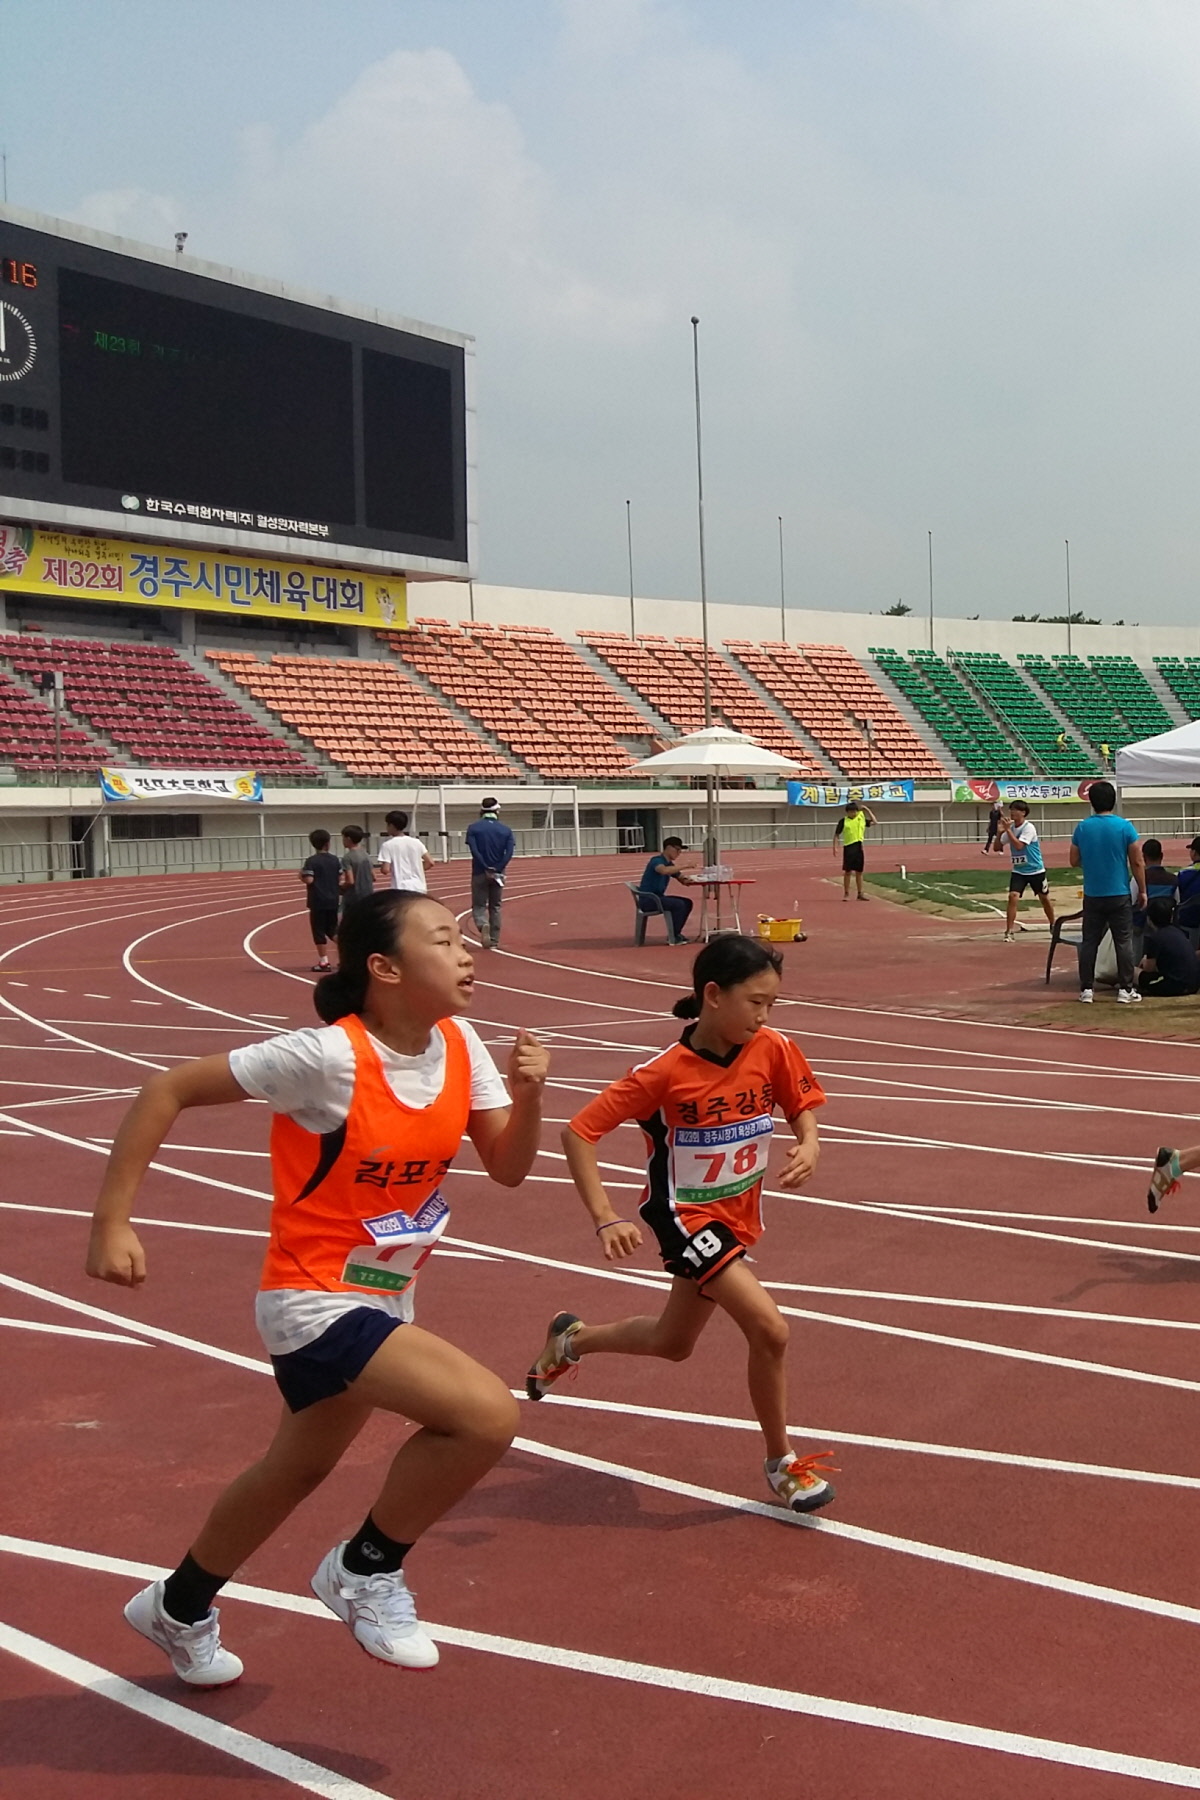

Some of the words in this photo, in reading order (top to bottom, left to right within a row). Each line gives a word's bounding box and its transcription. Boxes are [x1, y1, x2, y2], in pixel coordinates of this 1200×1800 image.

[9, 260, 37, 288] 16
[257, 514, 330, 537] 월성원자력본부
[42, 557, 123, 592] 제32회
[128, 552, 365, 614] 경주시민체육대회
[1006, 786, 1072, 798] 금장초등학교
[703, 1127, 738, 1144] 경주시장기
[694, 1142, 758, 1183] 78
[682, 1228, 722, 1268] 19
